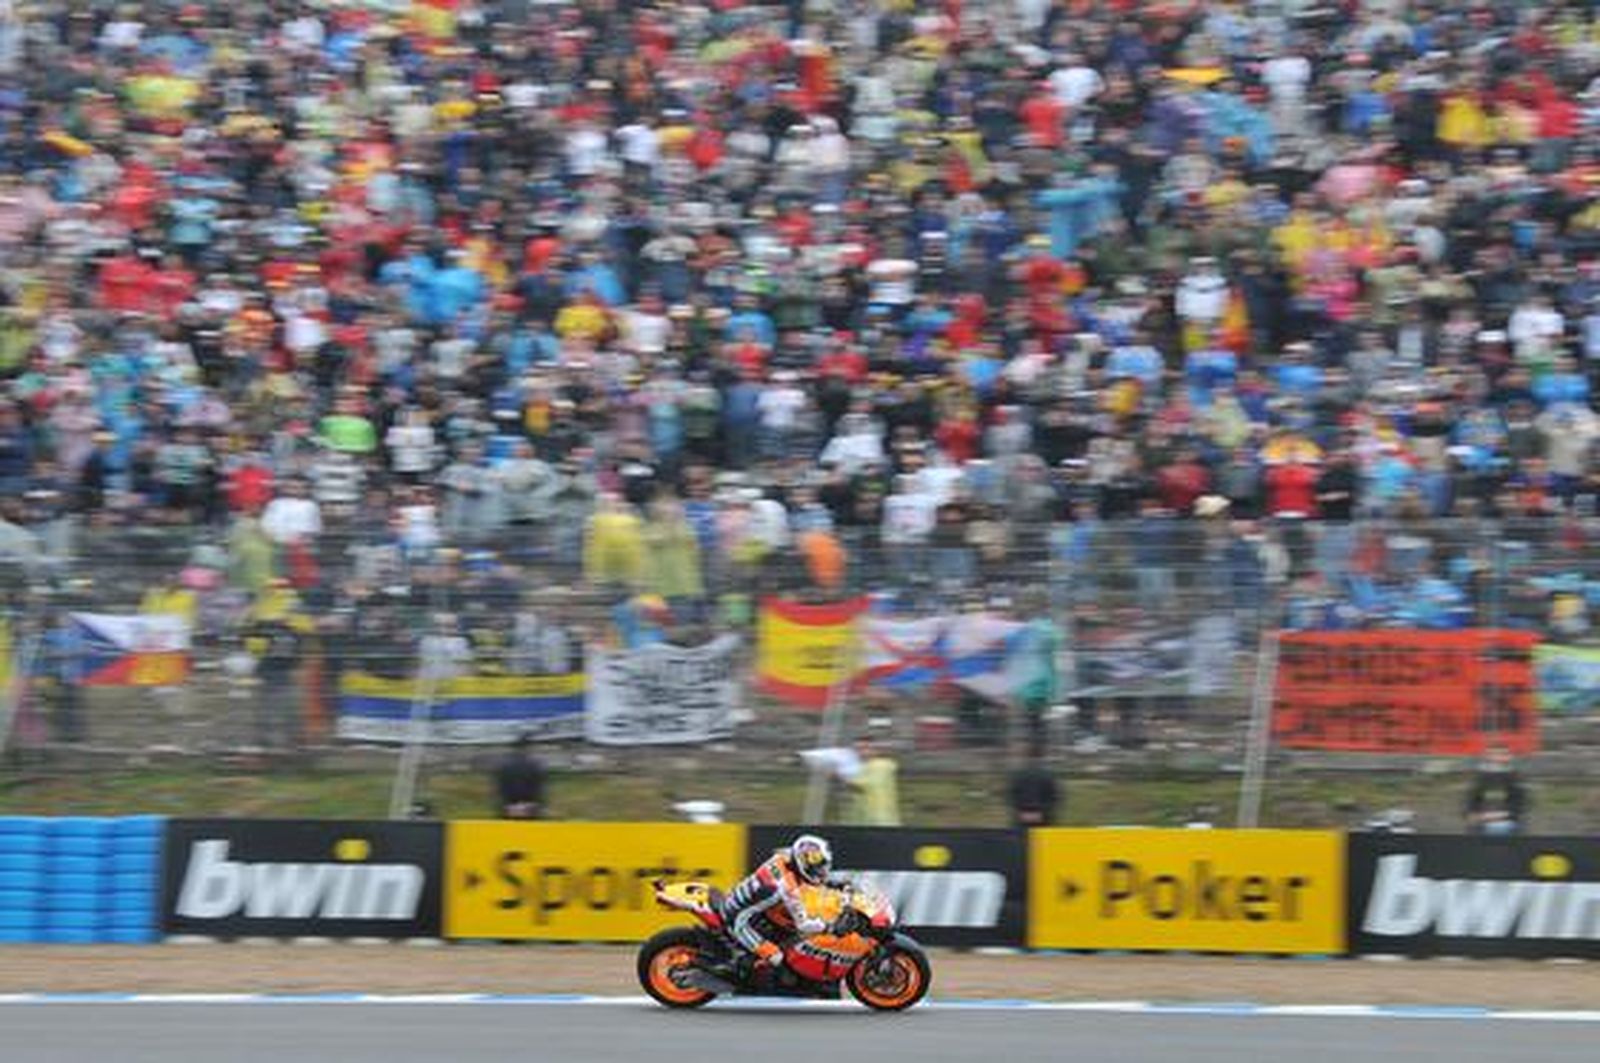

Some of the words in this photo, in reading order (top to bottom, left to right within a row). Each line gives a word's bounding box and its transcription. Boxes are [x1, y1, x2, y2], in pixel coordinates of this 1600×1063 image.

[175, 839, 425, 920] bwin
[495, 851, 714, 925] Sport
[1099, 860, 1308, 922] Poker
